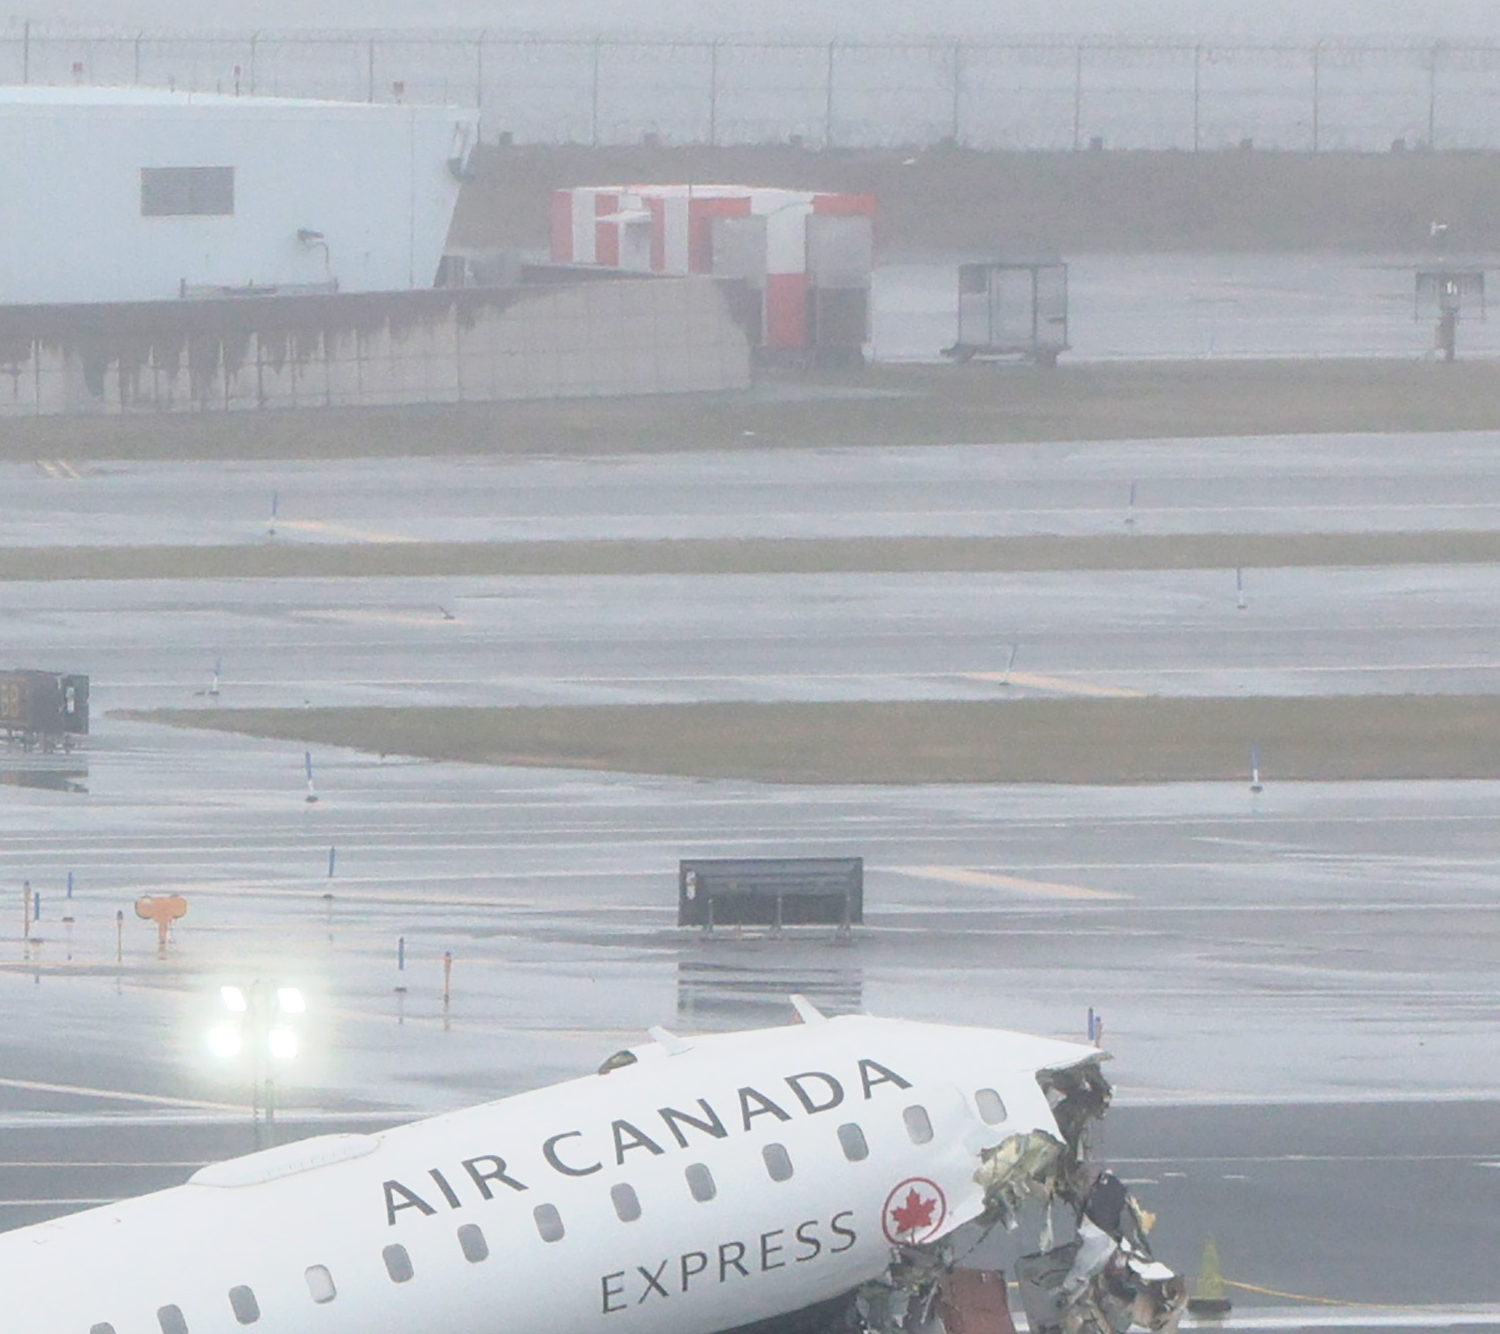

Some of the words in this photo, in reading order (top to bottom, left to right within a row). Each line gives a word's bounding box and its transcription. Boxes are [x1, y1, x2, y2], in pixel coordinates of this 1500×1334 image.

[382, 1154, 530, 1227] AIR
[542, 1058, 914, 1178] CANADA
[601, 1210, 858, 1315] EXPRESS
